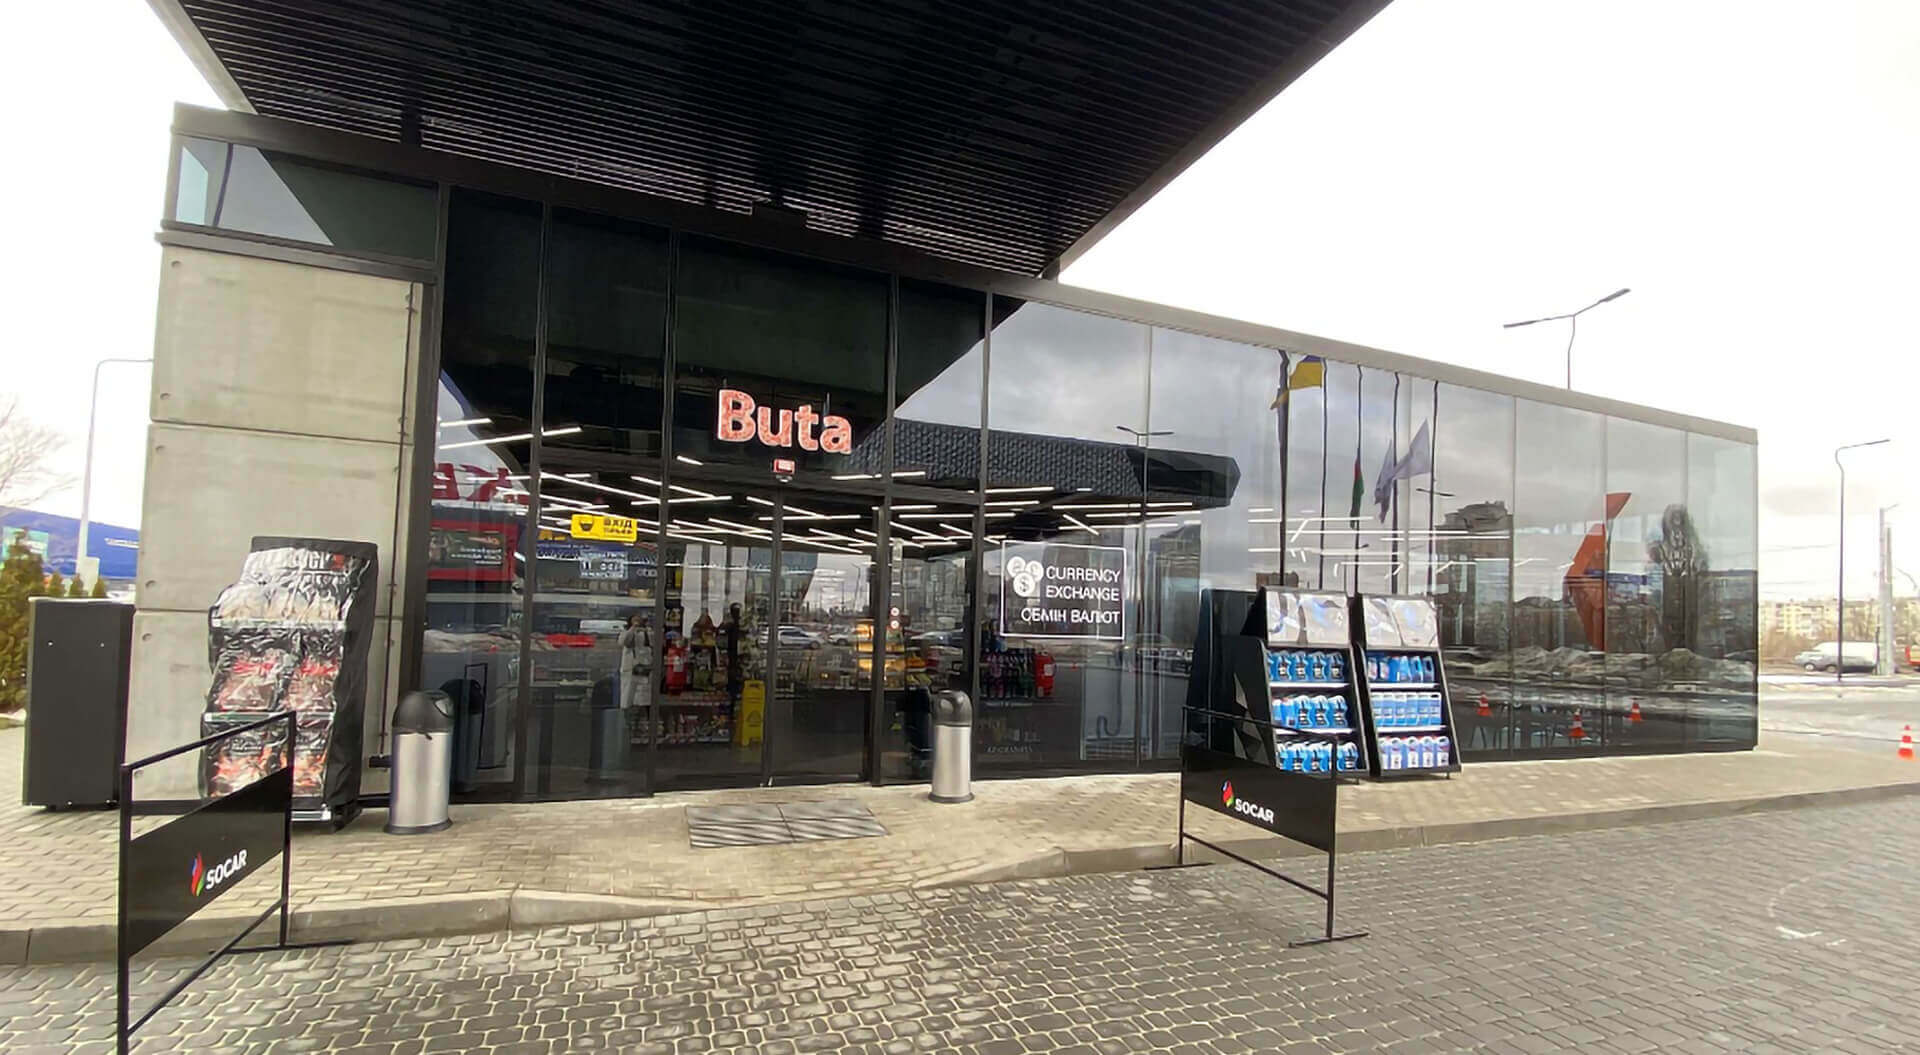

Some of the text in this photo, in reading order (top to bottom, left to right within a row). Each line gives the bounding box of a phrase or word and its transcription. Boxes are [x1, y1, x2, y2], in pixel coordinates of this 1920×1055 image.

[718, 389, 852, 454] Buta
[1046, 565, 1121, 583] CURRENCY
[1046, 585, 1120, 601] EXCHANGE
[1235, 798, 1274, 824] SOCAR
[206, 849, 248, 890] SOCAR
